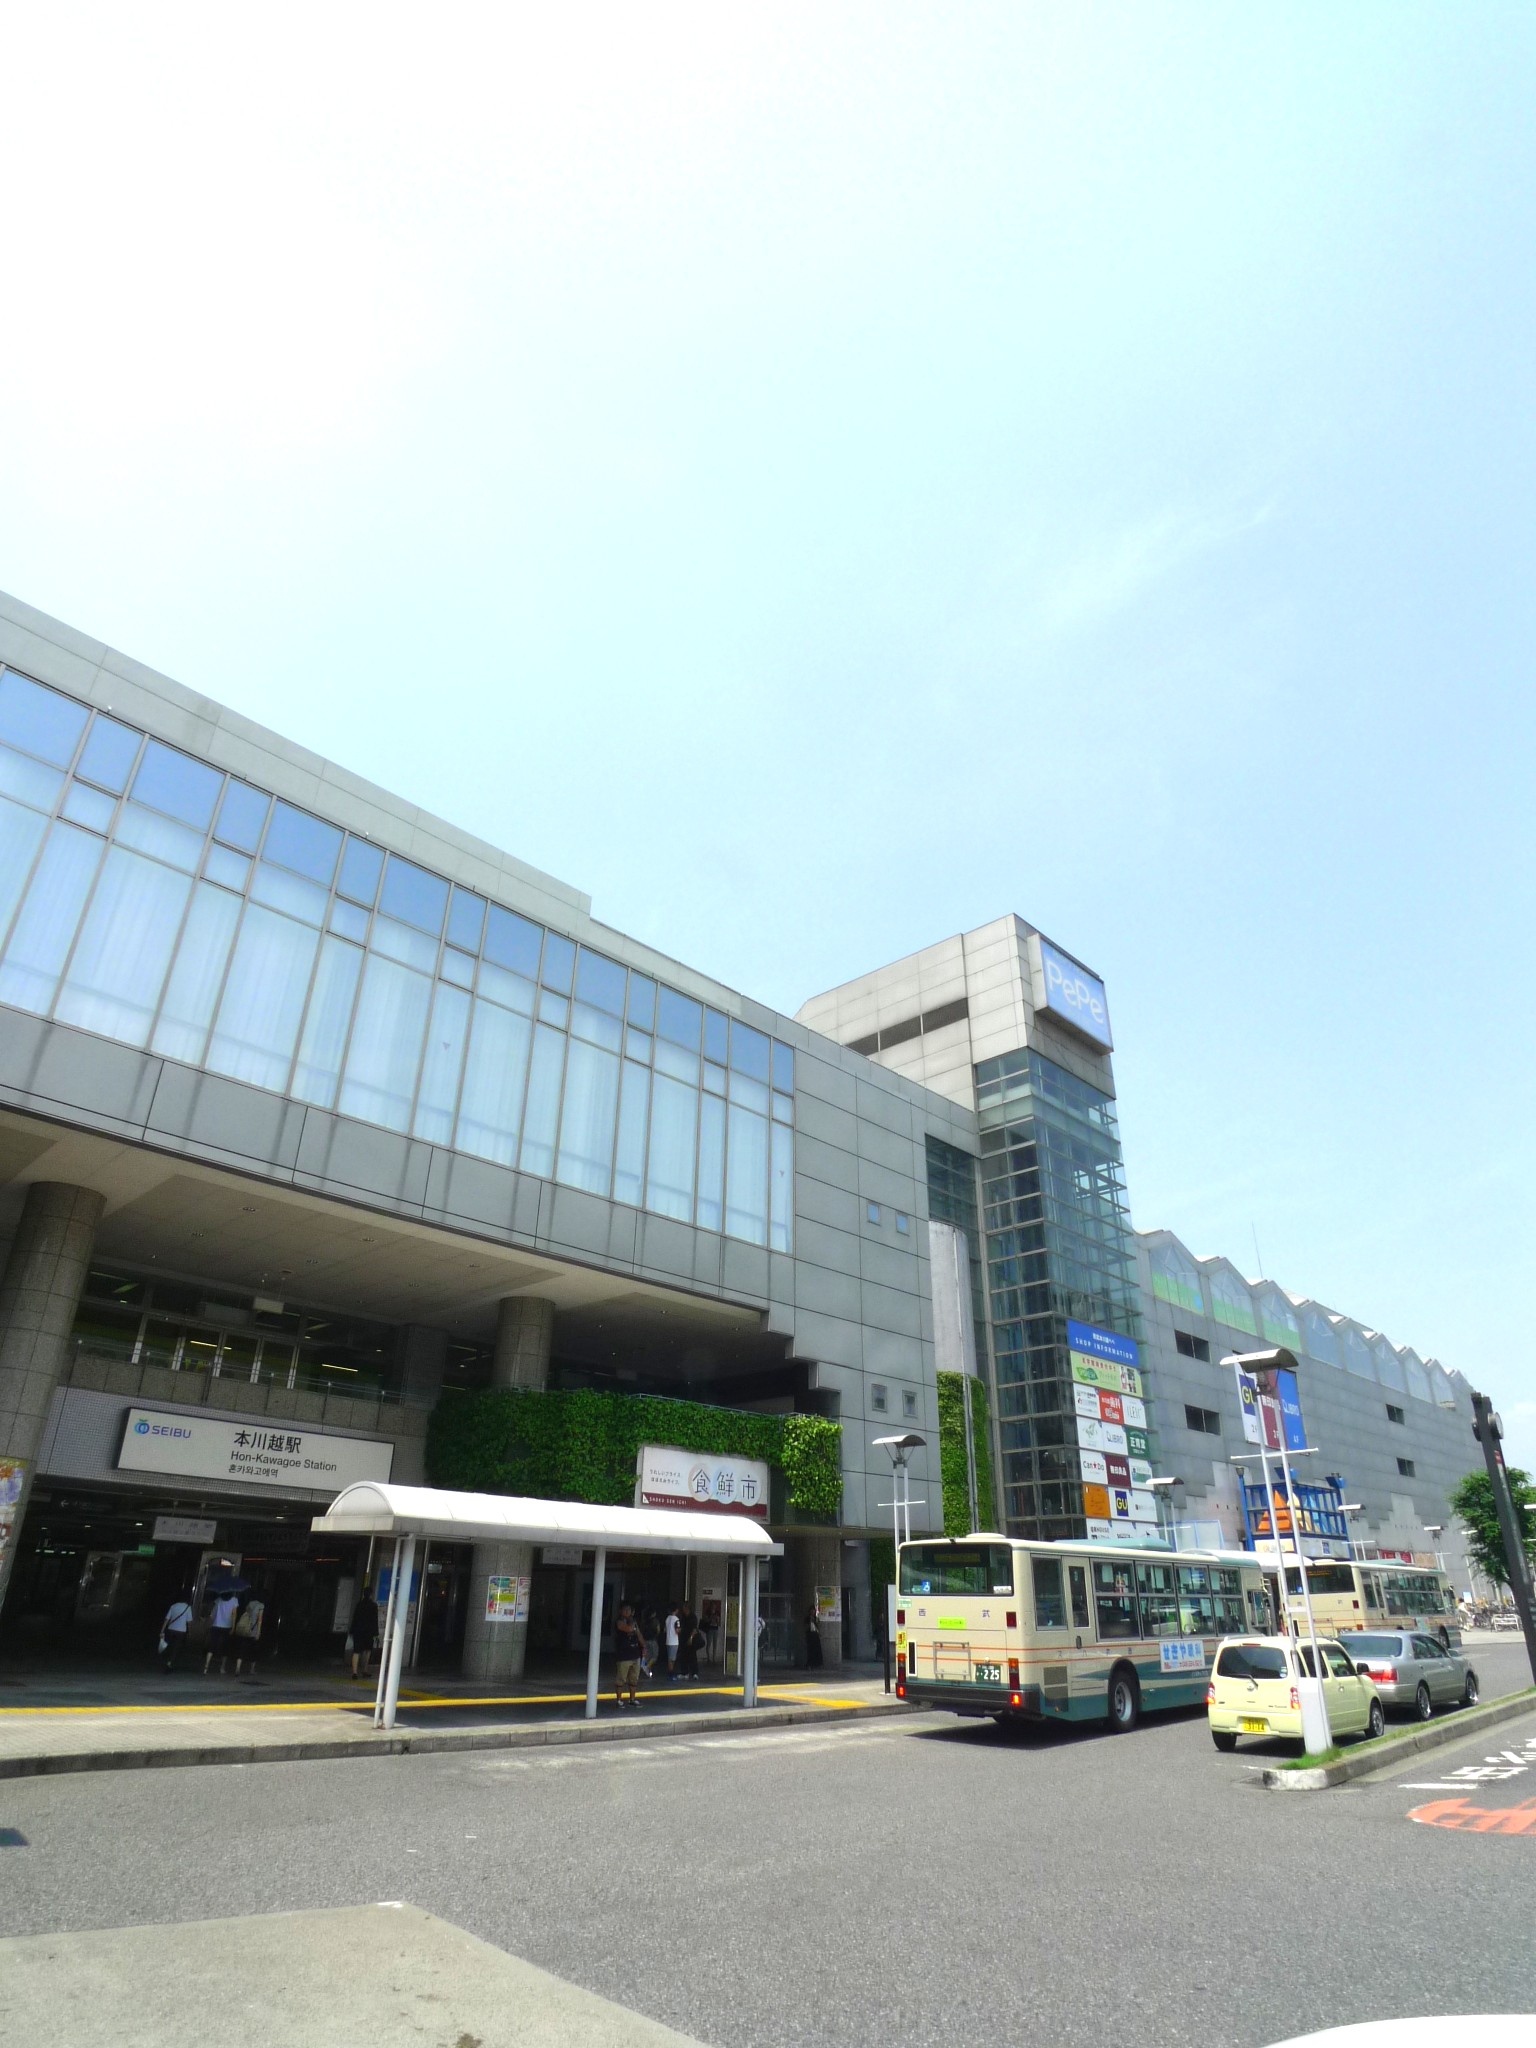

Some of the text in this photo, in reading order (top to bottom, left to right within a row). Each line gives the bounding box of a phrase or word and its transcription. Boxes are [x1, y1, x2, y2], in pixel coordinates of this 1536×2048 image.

[1075, 1337, 1133, 1359] SHOP INFORMATION
[152, 1425, 192, 1439] SEIBU
[233, 1430, 302, 1454] 本川越駅
[228, 1464, 279, 1478] 혼카와고에역
[230, 1450, 337, 1472] Hon-Kawagoe Station
[692, 1468, 758, 1500] 食鮮市
[1116, 1497, 1128, 1510] GU
